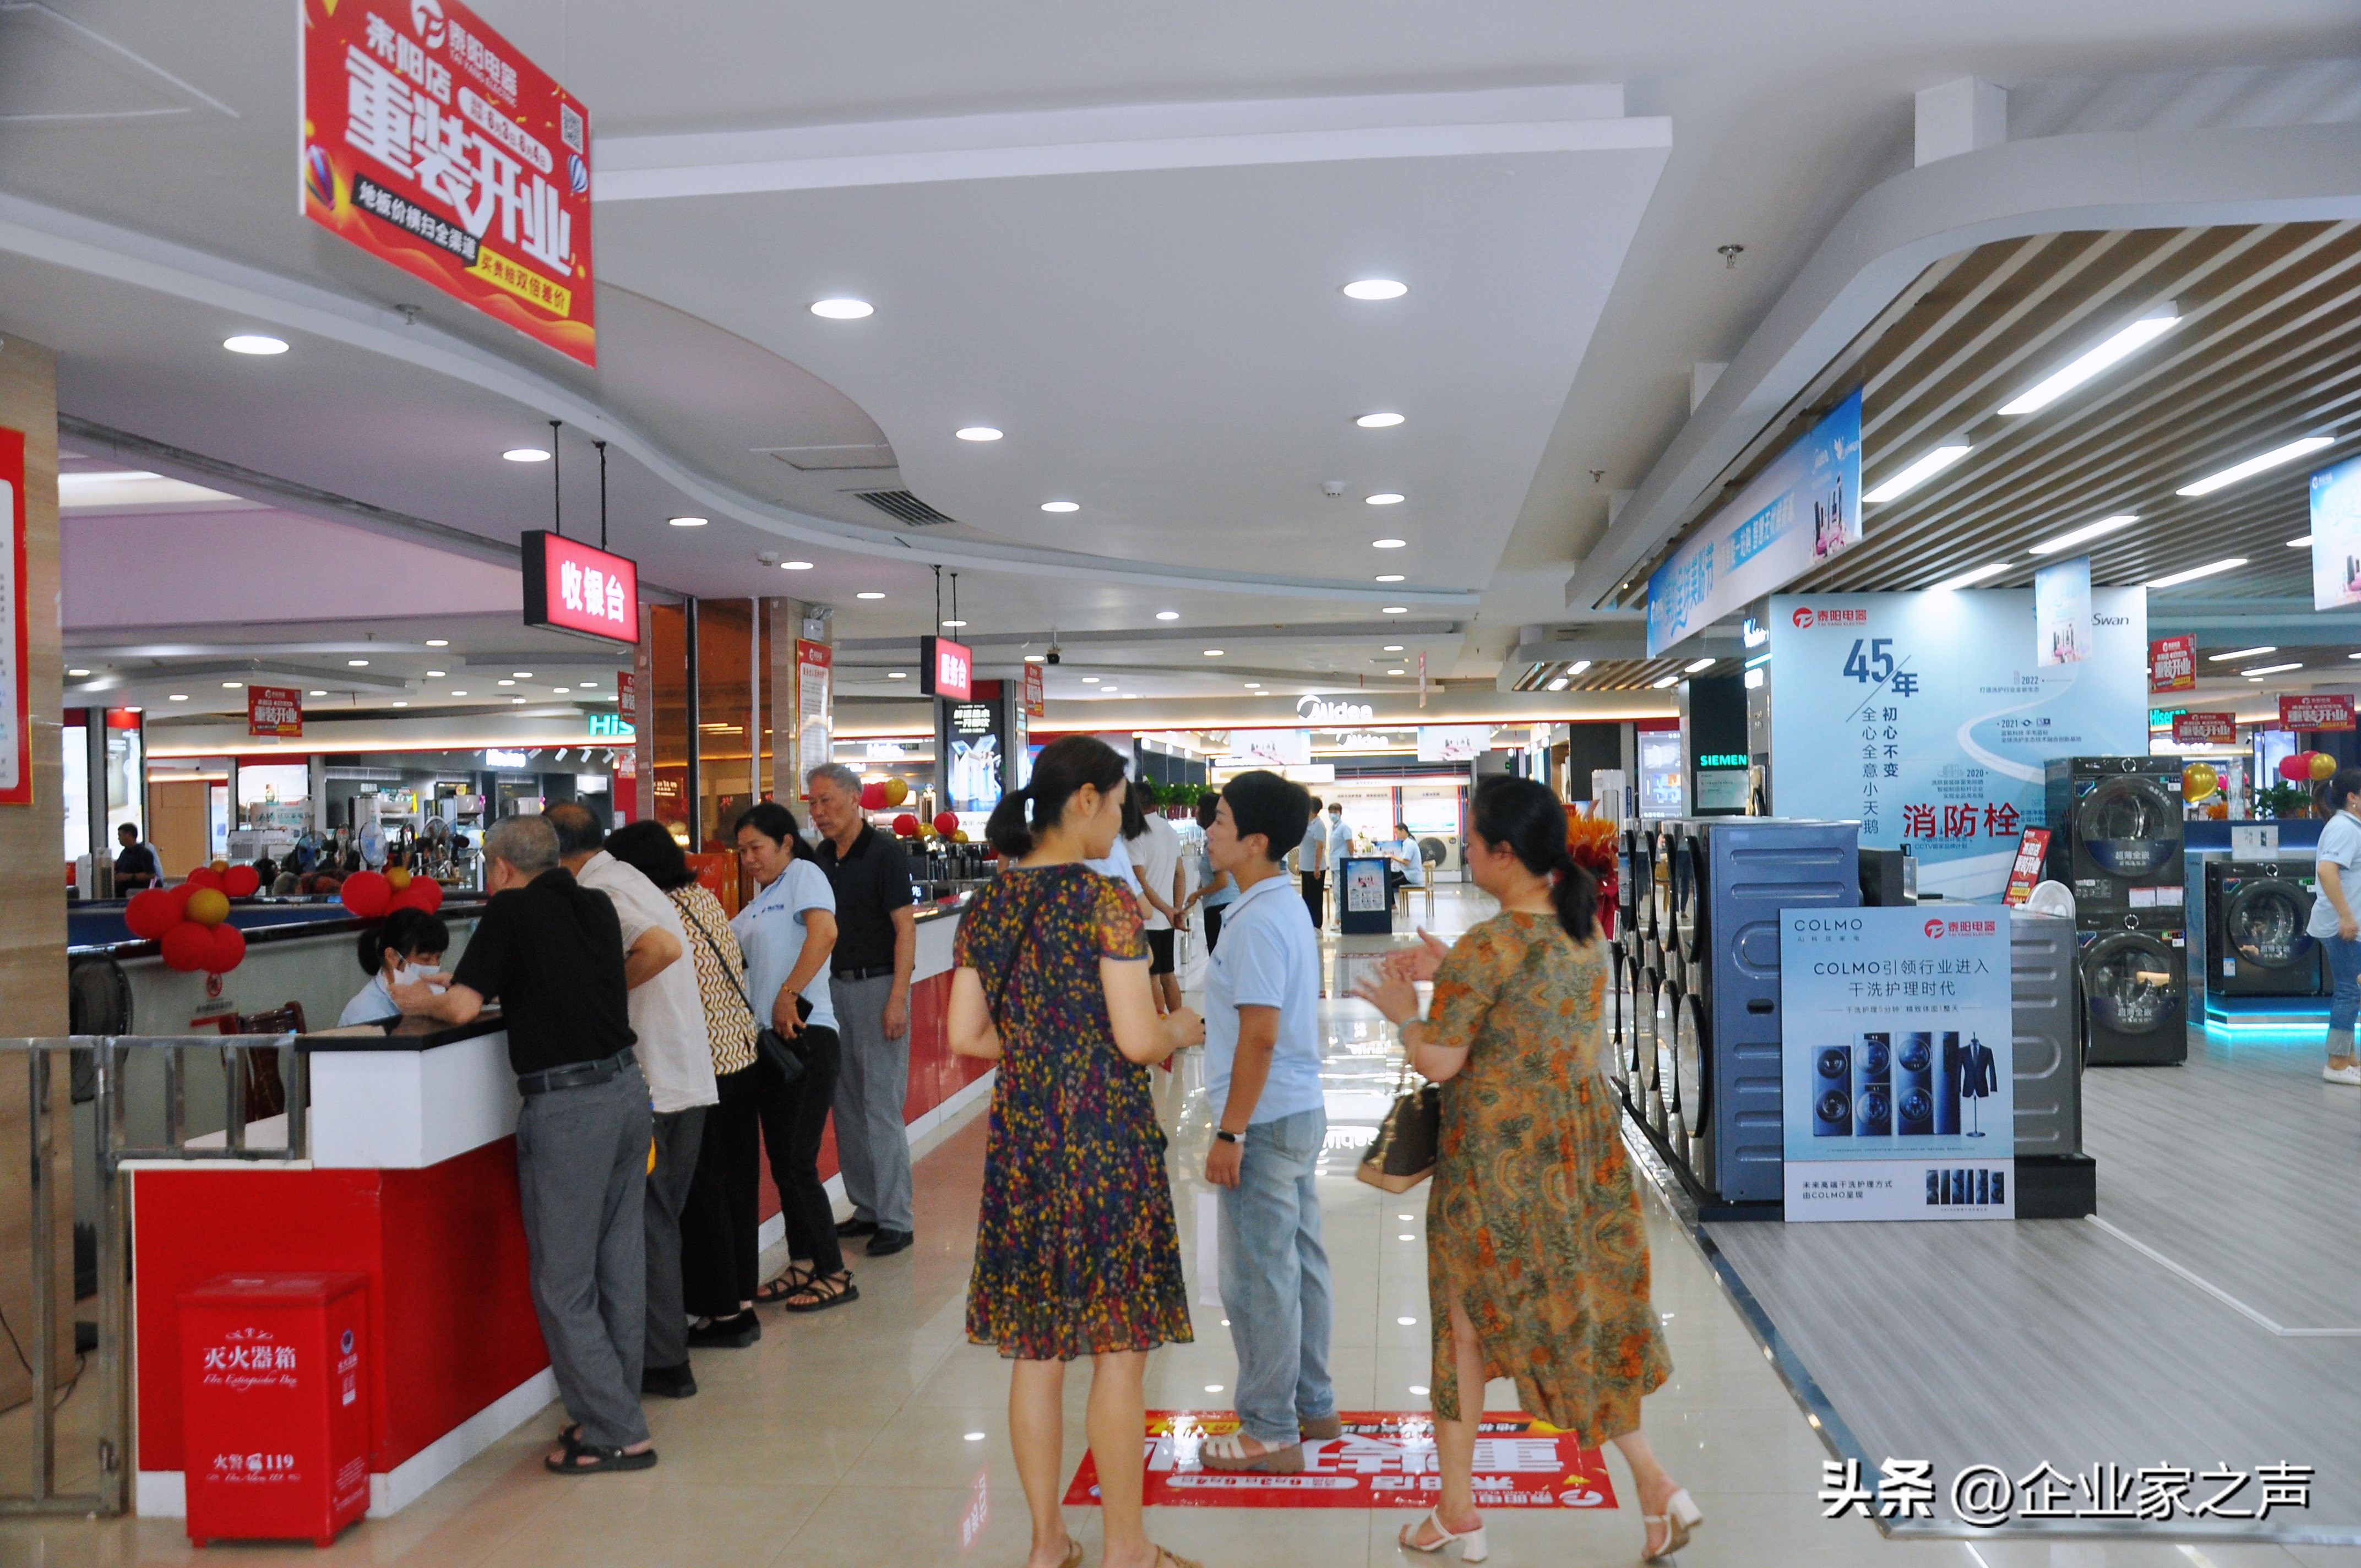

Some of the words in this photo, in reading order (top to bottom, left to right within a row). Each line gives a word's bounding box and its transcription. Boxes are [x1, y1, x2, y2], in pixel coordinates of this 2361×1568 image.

[345, 44, 572, 276] 重装开业
[561, 559, 625, 623] 收银台
[1818, 609, 1867, 622] 泰阳电器
[2021, 676, 2039, 685] 2022
[2001, 719, 2018, 728] 2021
[1883, 706, 1899, 777] 初心不变
[1700, 754, 1749, 767] SIEMEN
[1862, 706, 1879, 834] 全心全意小天鹅
[1966, 769, 1984, 777] 2020
[1903, 802, 2020, 837] 消防栓
[1794, 918, 1863, 932] COLMO
[1948, 921, 1995, 932] 泰阳电器
[1814, 958, 1989, 976] COLMO引领行业进入
[1848, 980, 1956, 997] 干洗护理时代
[1803, 1180, 1893, 1189] 未来高端干洗护理方式
[1803, 1191, 1863, 1199] 由COLMO呈现
[203, 1345, 296, 1369] 灭火器箱
[266, 1453, 295, 1470] 119
